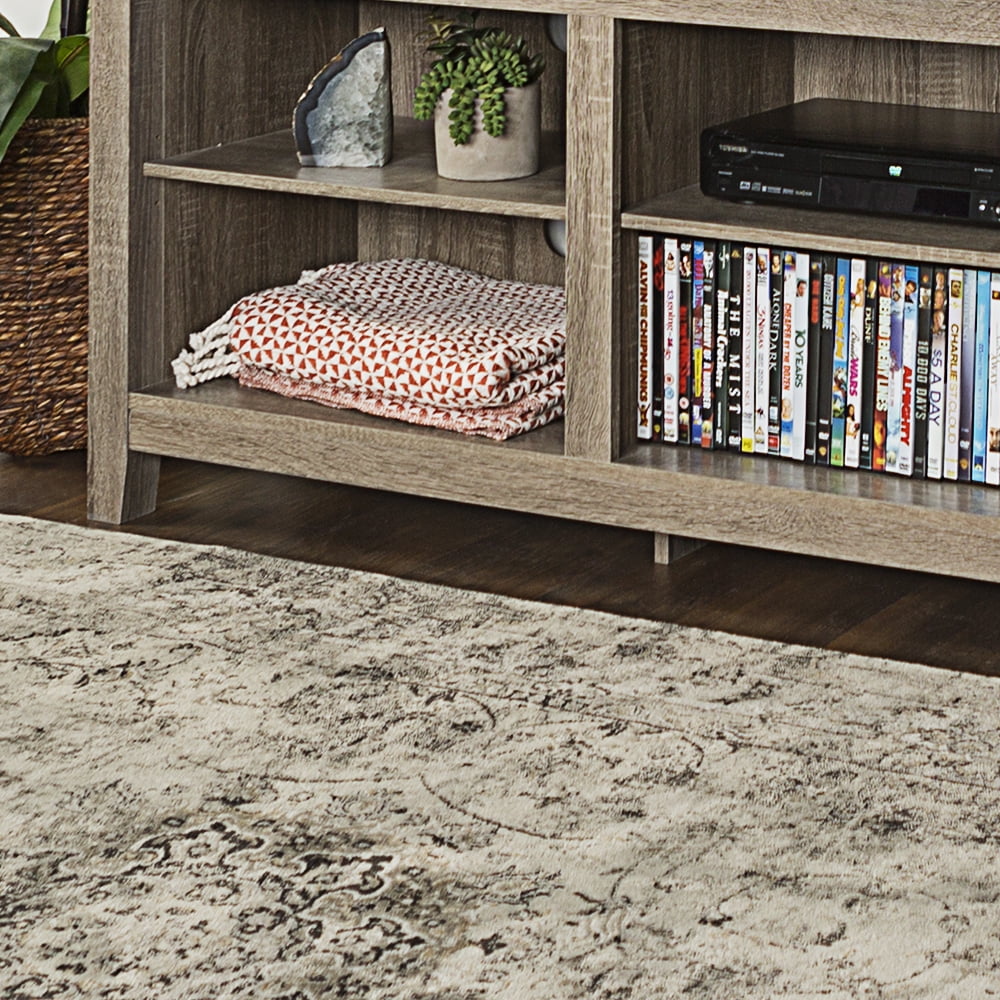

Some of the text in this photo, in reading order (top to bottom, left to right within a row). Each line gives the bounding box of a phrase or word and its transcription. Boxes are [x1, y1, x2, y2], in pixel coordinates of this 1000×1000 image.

[719, 143, 748, 154] TOSHIBA
[640, 260, 648, 303] ALVIN
[703, 304, 712, 348] ANATOMY
[716, 290, 728, 334] Animal
[758, 318, 766, 350] NINJAS
[768, 288, 781, 372] ALONE DARK
[784, 303, 792, 339] CHEAPER
[822, 305, 832, 330] KANE
[864, 307, 872, 344] DUNE
[640, 319, 648, 402] CHIPMUNKS
[703, 349, 712, 361] OF
[715, 335, 728, 388] Crackers
[729, 294, 741, 414] THE MIST
[784, 340, 790, 350] BY
[794, 329, 806, 389] 10 YEARS
[876, 296, 891, 412] BEHIND ENEMY LINES
[783, 365, 791, 391] DOZEN
[849, 357, 859, 397] WARS
[915, 340, 929, 421] 10,000 DAYS
[929, 349, 942, 427] $5 A DAY
[947, 323, 959, 444] CHARLIE ST CLOUD
[900, 365, 913, 446] ALMIGHTY
